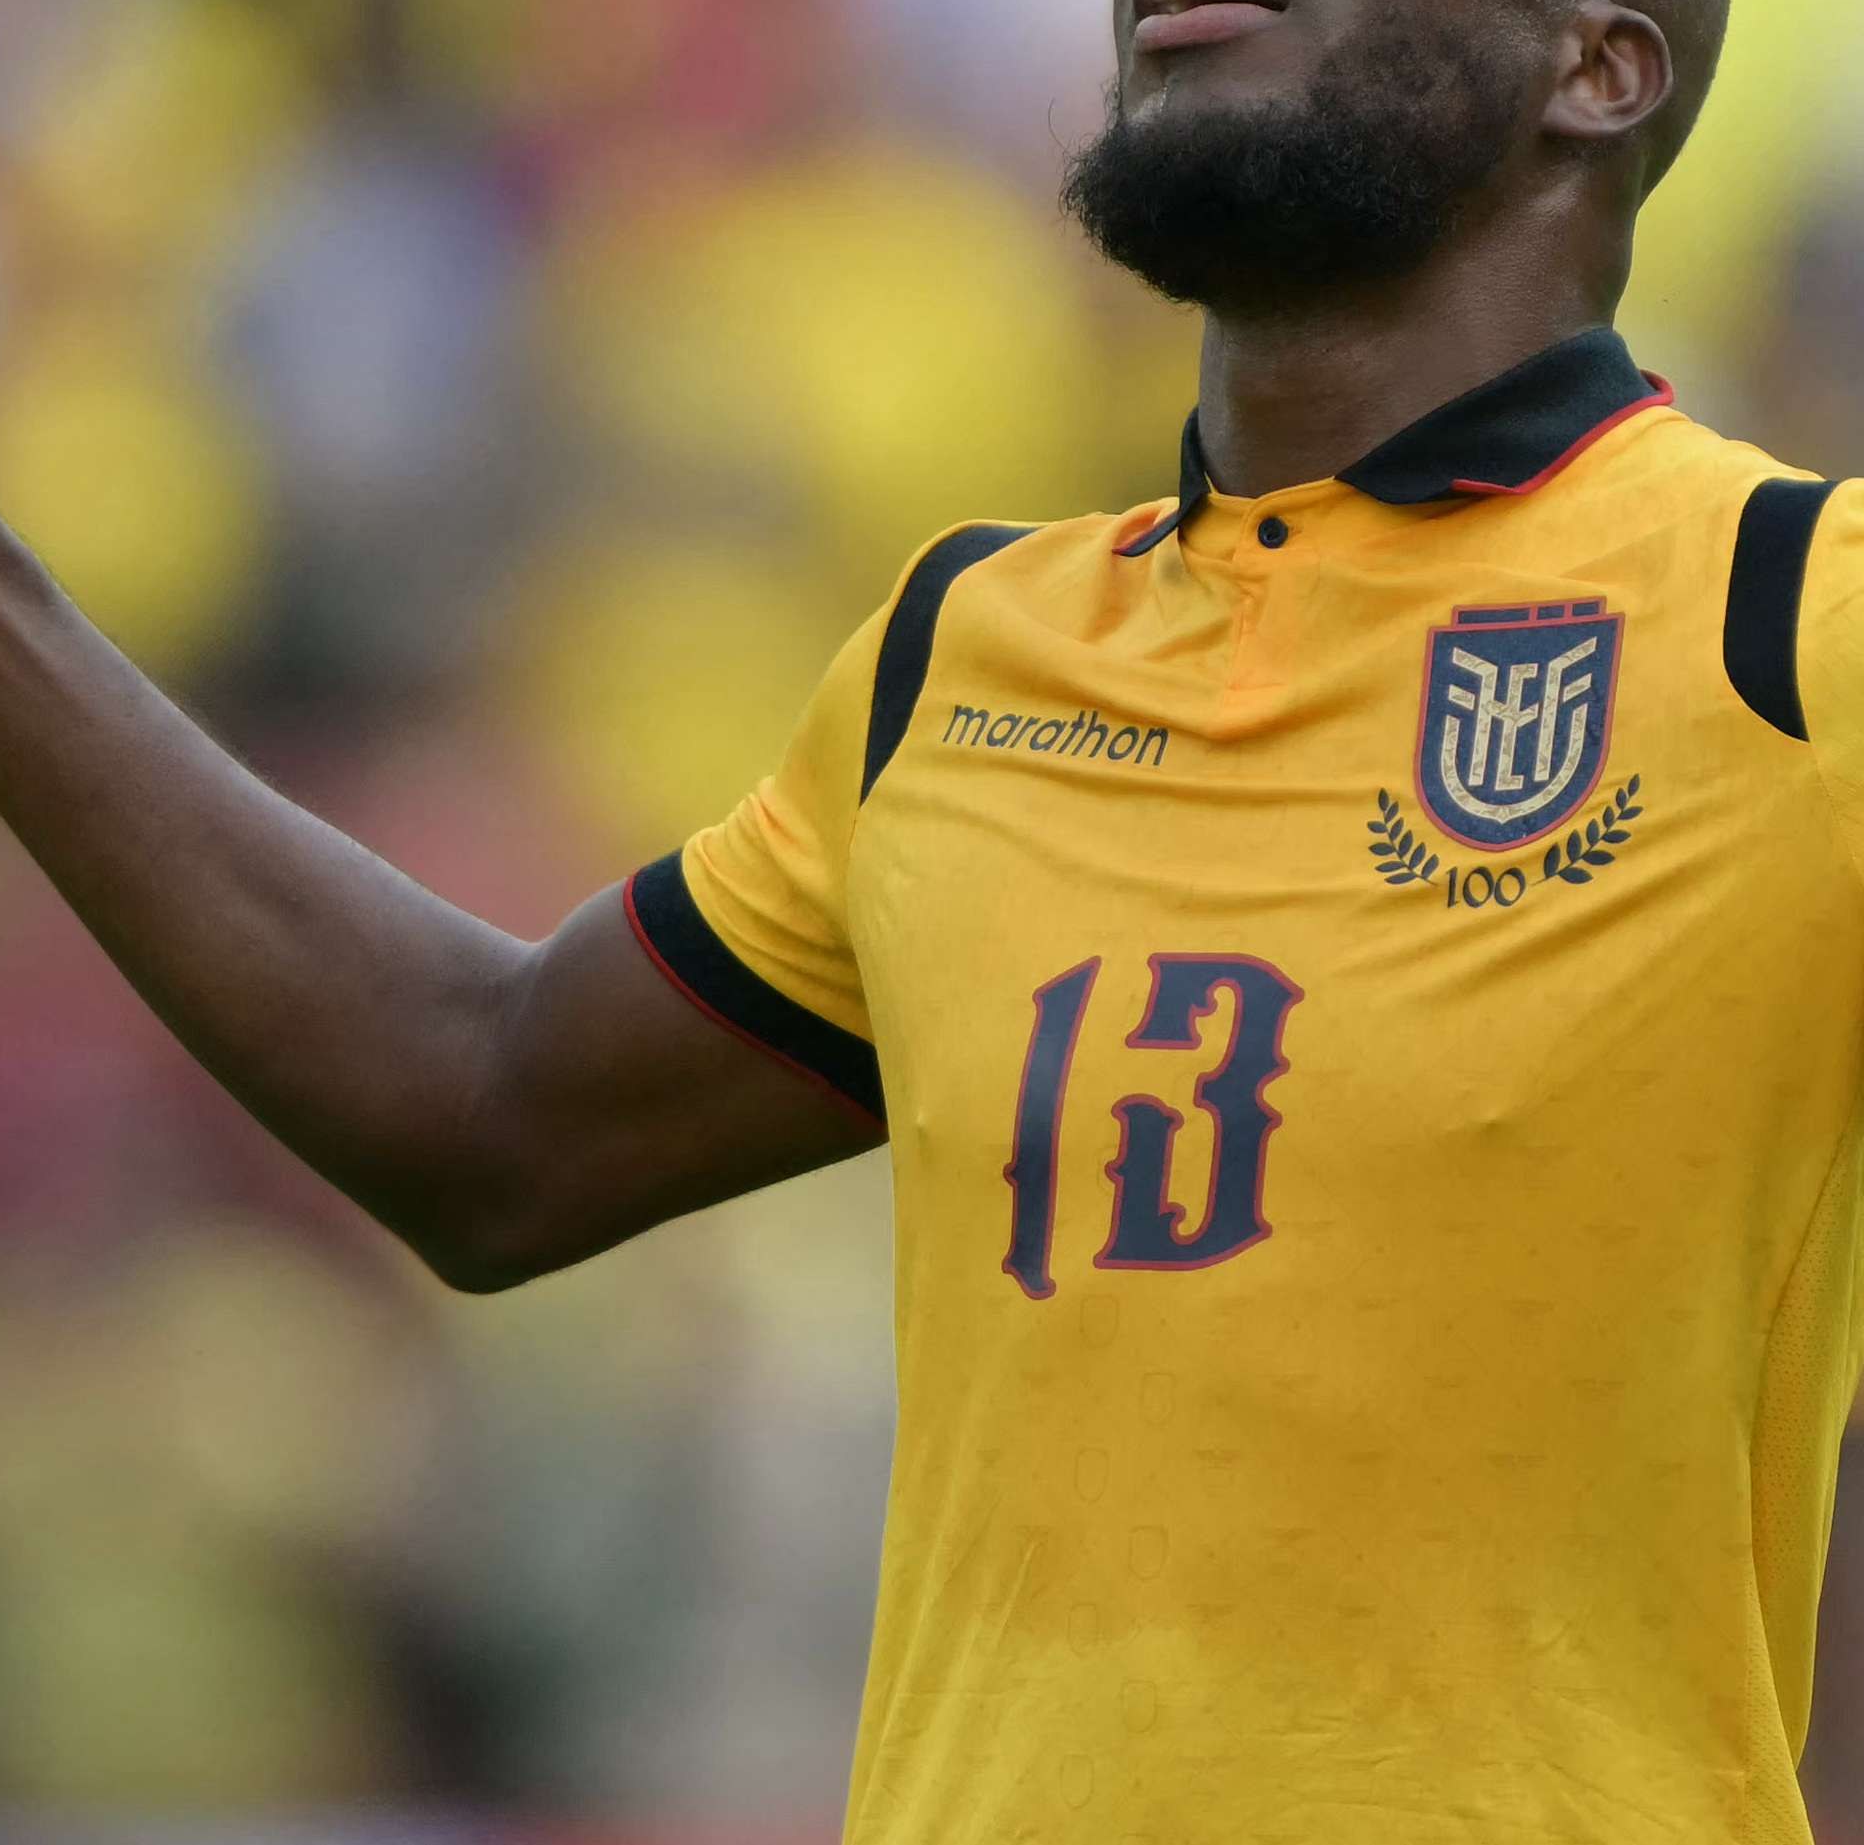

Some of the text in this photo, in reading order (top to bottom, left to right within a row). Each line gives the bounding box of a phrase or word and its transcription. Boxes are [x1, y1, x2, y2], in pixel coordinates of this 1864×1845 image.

[942, 703, 1169, 766] marathon
[1446, 865, 1527, 908] 100
[1002, 953, 1305, 1300] 13
